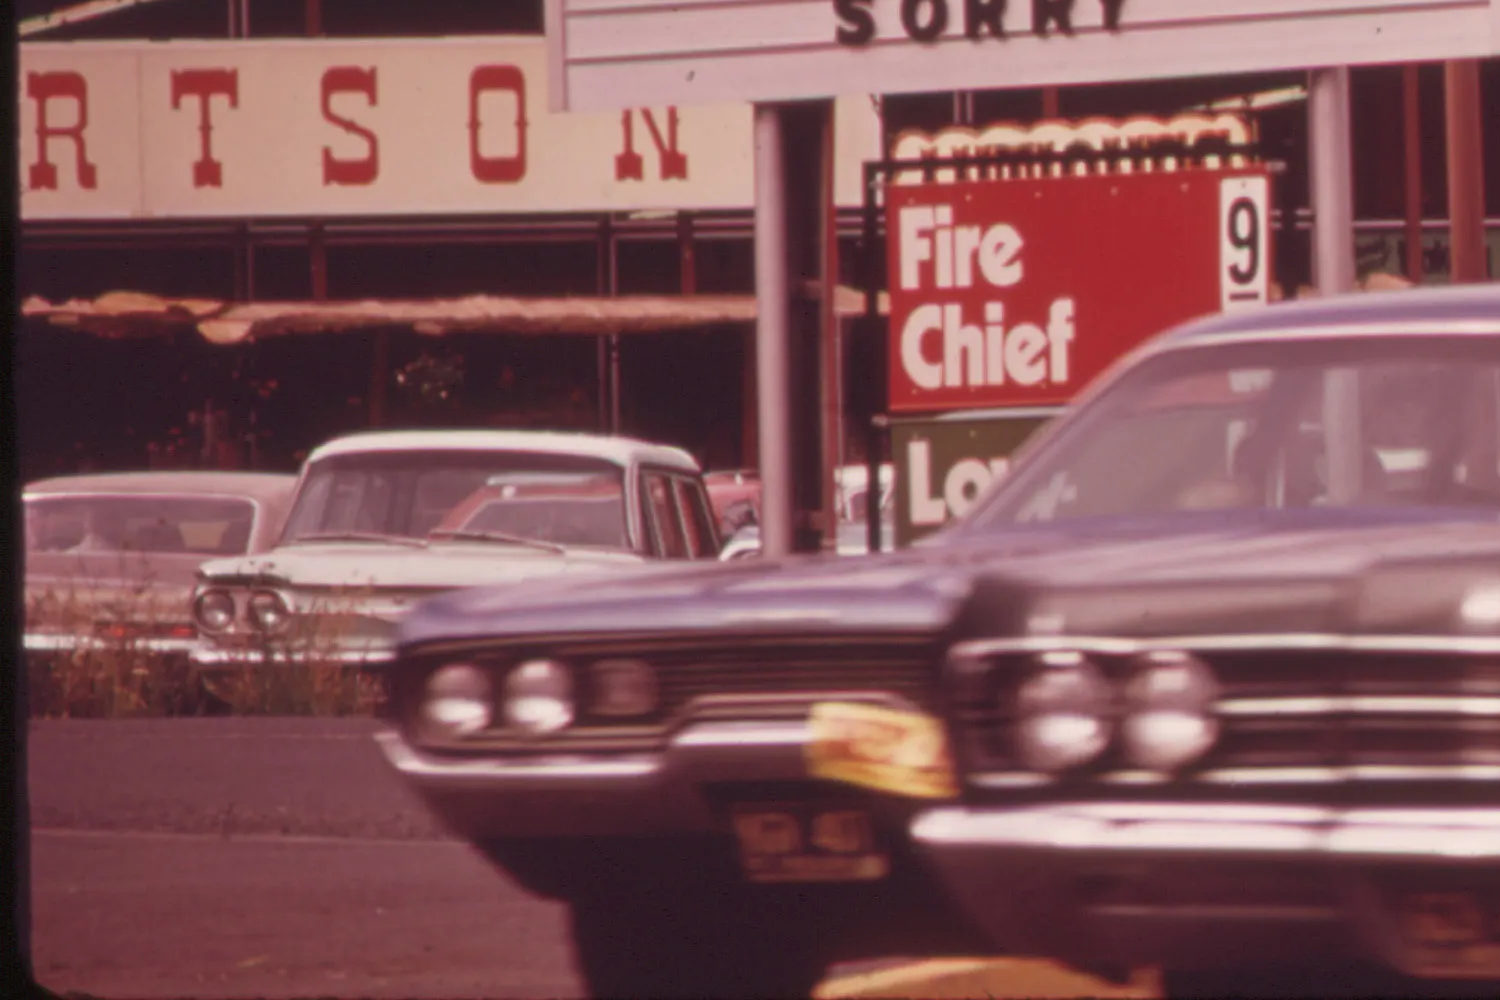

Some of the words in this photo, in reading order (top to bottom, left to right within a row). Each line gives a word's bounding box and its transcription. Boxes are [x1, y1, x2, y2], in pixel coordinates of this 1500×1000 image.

[898, 205, 1024, 290] Fire
[1228, 196, 1259, 285] 9
[901, 298, 1076, 389] Chief
[908, 440, 1011, 525] Lo
